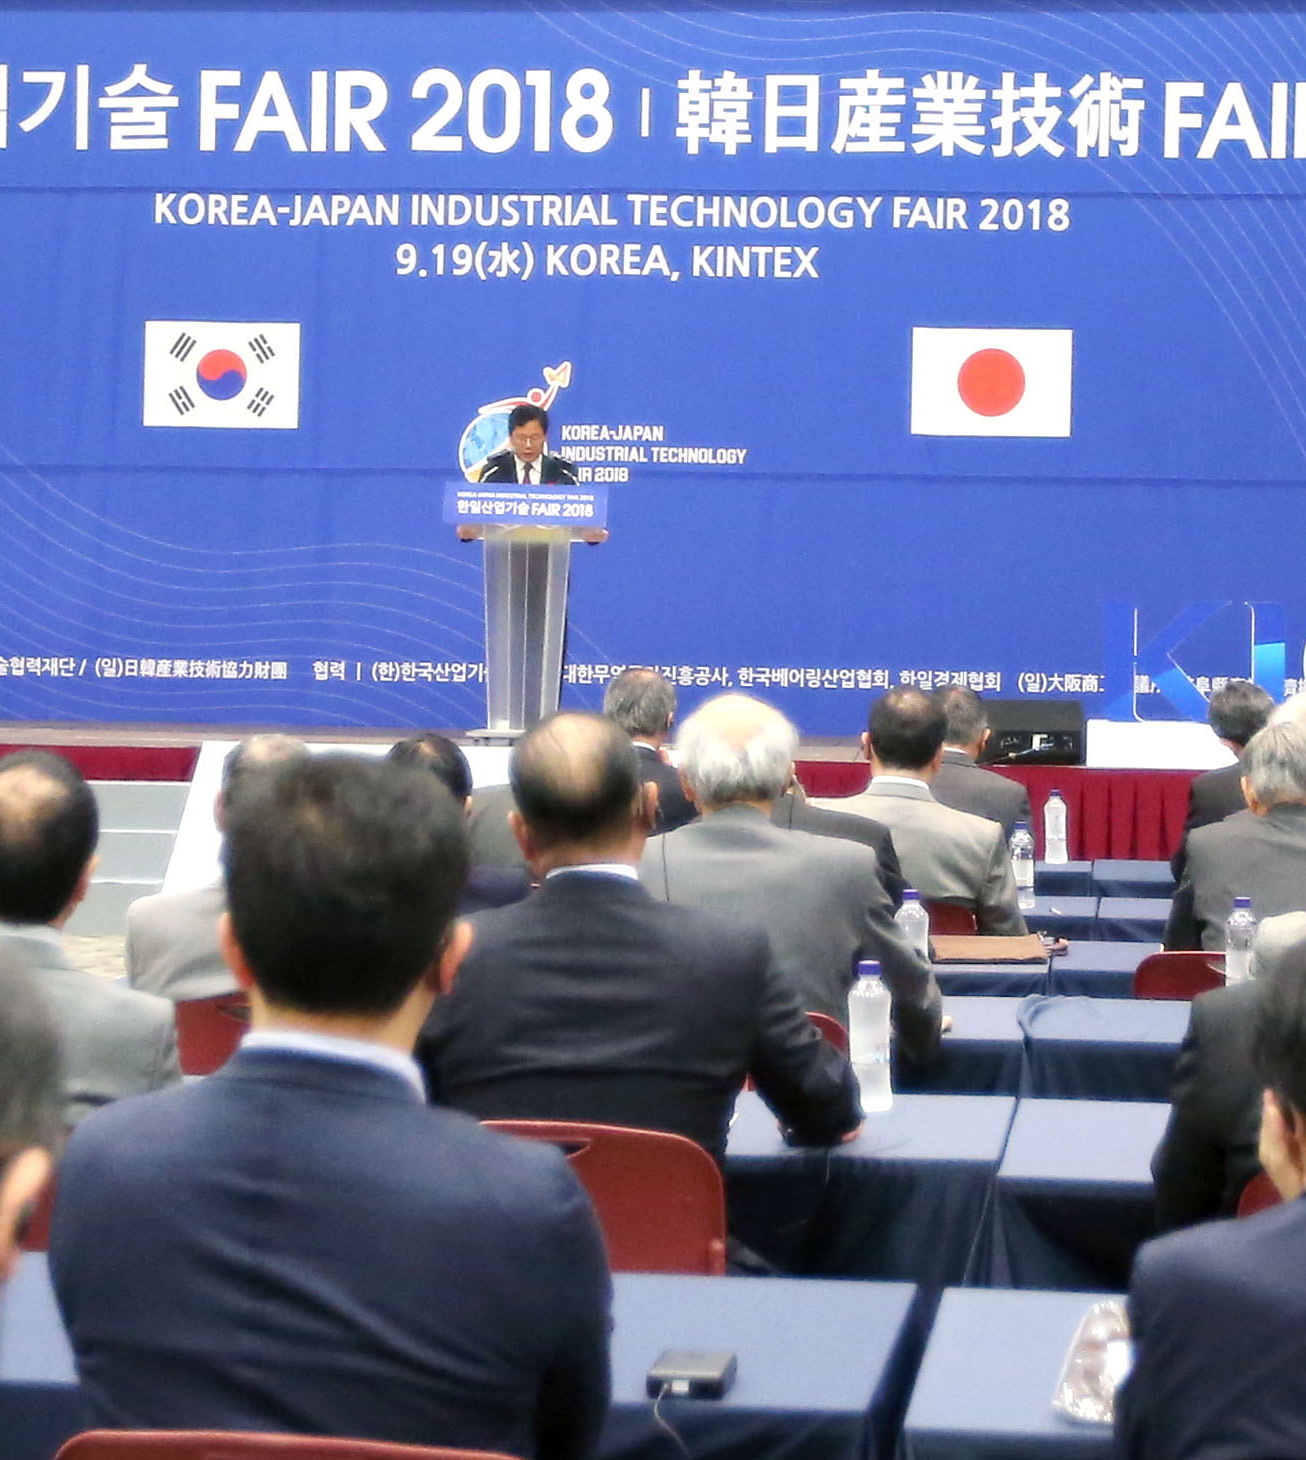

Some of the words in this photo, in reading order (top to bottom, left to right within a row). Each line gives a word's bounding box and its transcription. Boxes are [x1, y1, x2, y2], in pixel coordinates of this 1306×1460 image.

[198, 68, 390, 152] FAIR
[411, 68, 614, 154] 2018
[675, 68, 1147, 158] 韓日産業技術
[154, 192, 399, 226] KOREA-JAPAN
[411, 193, 618, 228] INDUSTRIAL
[627, 195, 883, 230] TECHNOLOGY
[893, 197, 970, 230] FAIR
[978, 198, 1071, 232] 2018
[395, 242, 534, 280] 9.19(水)
[546, 243, 681, 282] KOREA,
[693, 246, 820, 279] KINTEX
[561, 424, 664, 442] KOREA-JAPAN
[561, 446, 648, 464] INDUSTRIAL
[652, 448, 747, 465] TECHNOLOGY
[593, 466, 629, 483] 2018
[457, 500, 531, 516] 한일산업기술
[531, 502, 562, 517] FAIR
[562, 503, 594, 518] 2018
[312, 660, 346, 681] 협력
